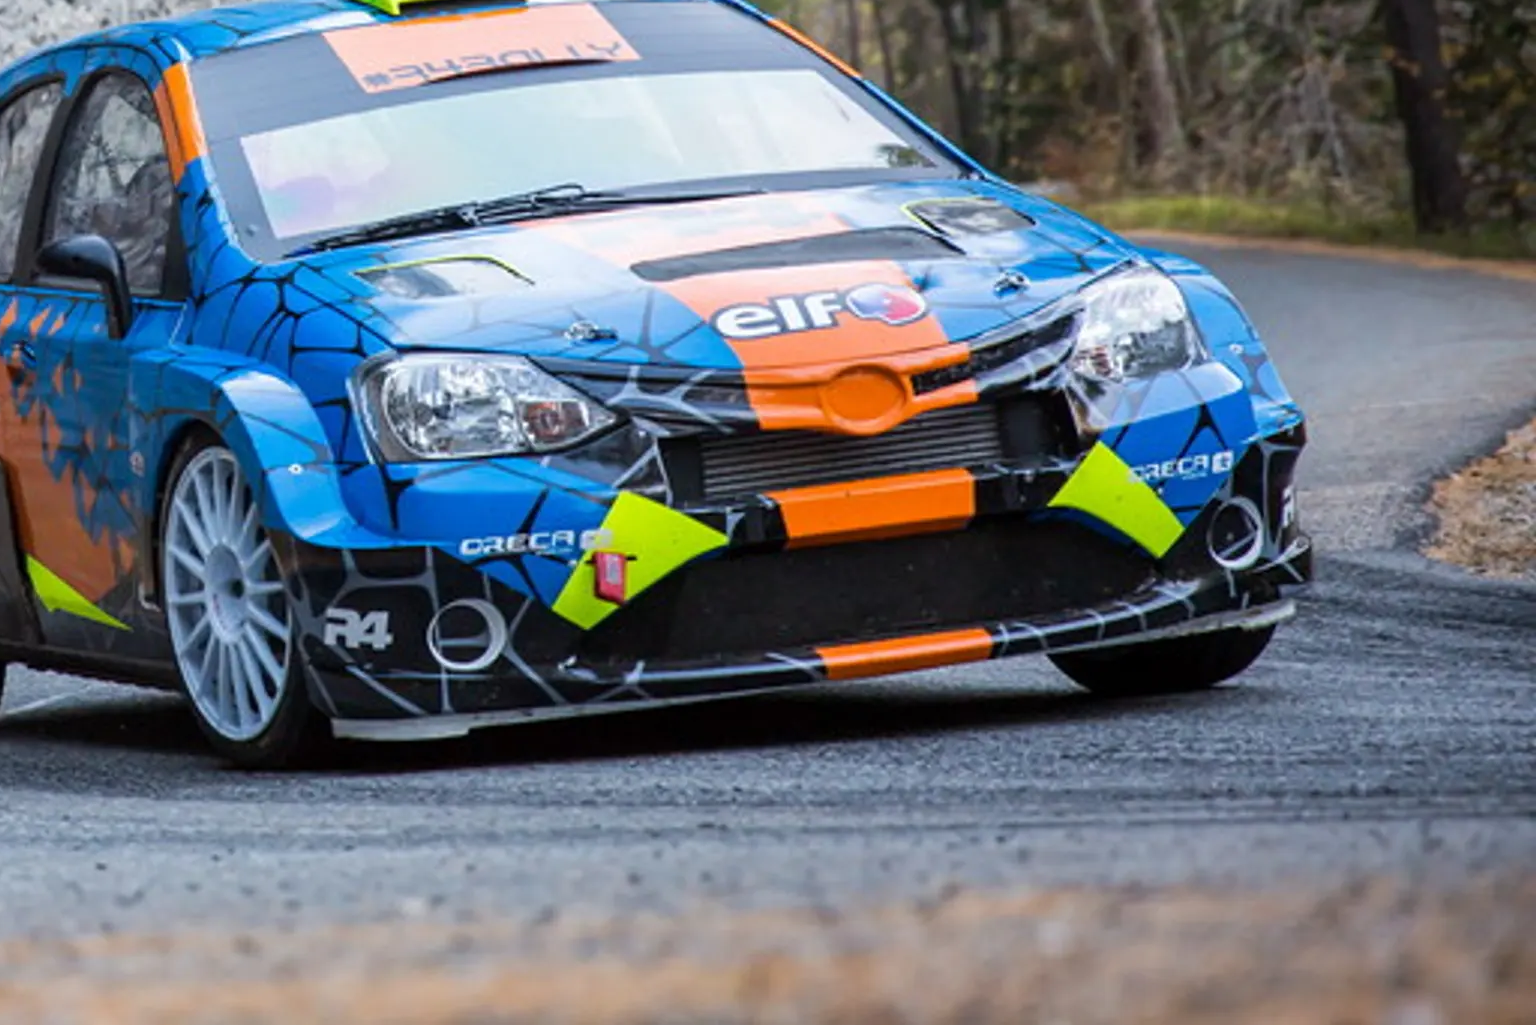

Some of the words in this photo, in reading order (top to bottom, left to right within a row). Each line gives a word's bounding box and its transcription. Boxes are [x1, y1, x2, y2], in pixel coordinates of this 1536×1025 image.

[715, 291, 842, 339] elf
[1128, 454, 1209, 483] ORECA
[460, 529, 575, 556] ORECA
[324, 607, 394, 651] R4
